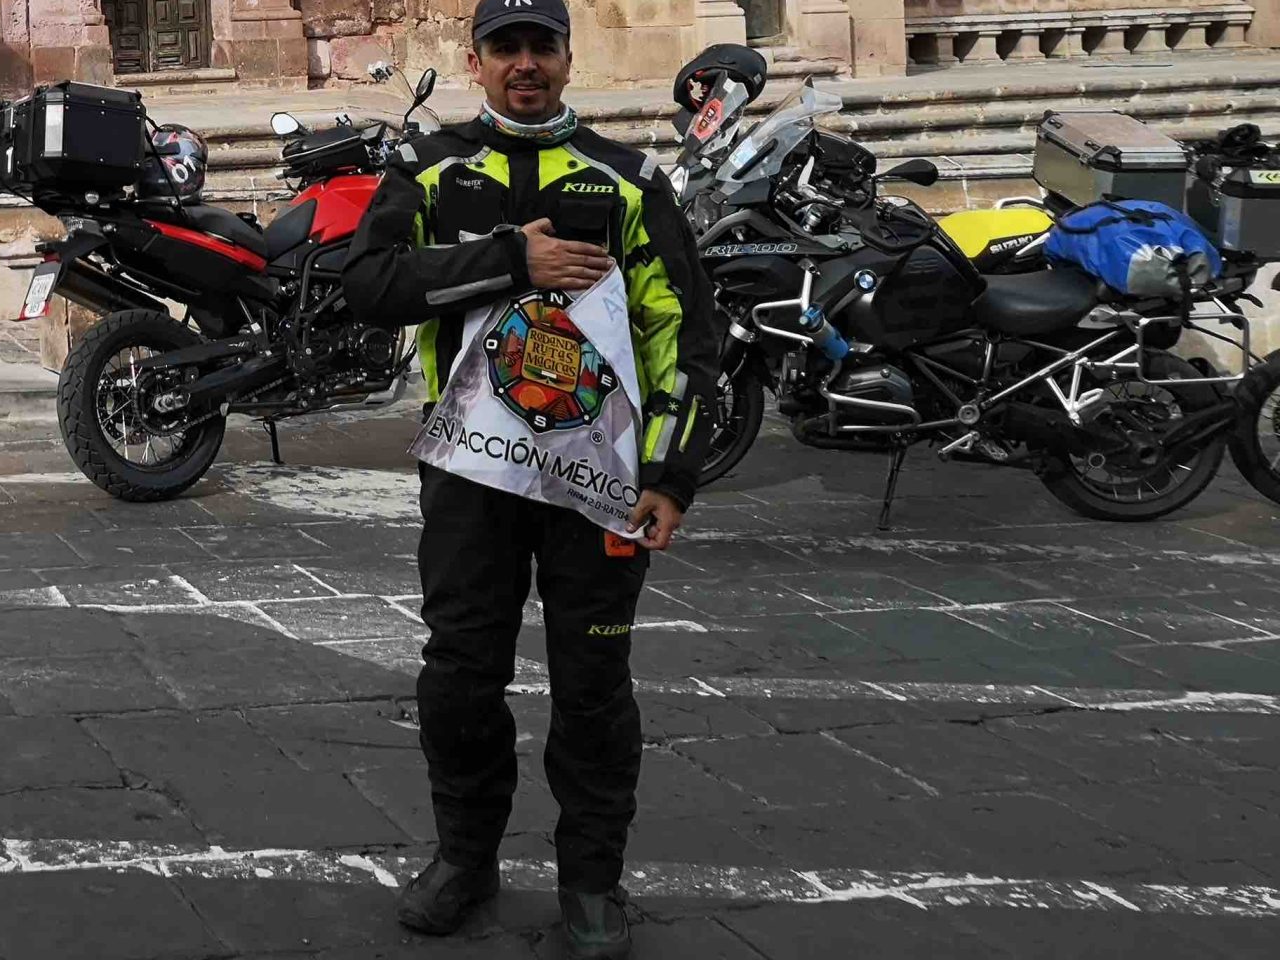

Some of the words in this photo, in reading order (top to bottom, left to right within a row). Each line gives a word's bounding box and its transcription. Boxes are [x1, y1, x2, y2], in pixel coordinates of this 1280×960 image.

[704, 243, 798, 256] R1200
[989, 235, 1034, 254] SUZUKI
[549, 292, 564, 306] N
[485, 338, 498, 349] O
[600, 373, 613, 388] E
[533, 415, 547, 428] S
[428, 415, 455, 443] EN
[456, 431, 548, 472] ACCIÓN
[550, 455, 640, 508] MÉXICO
